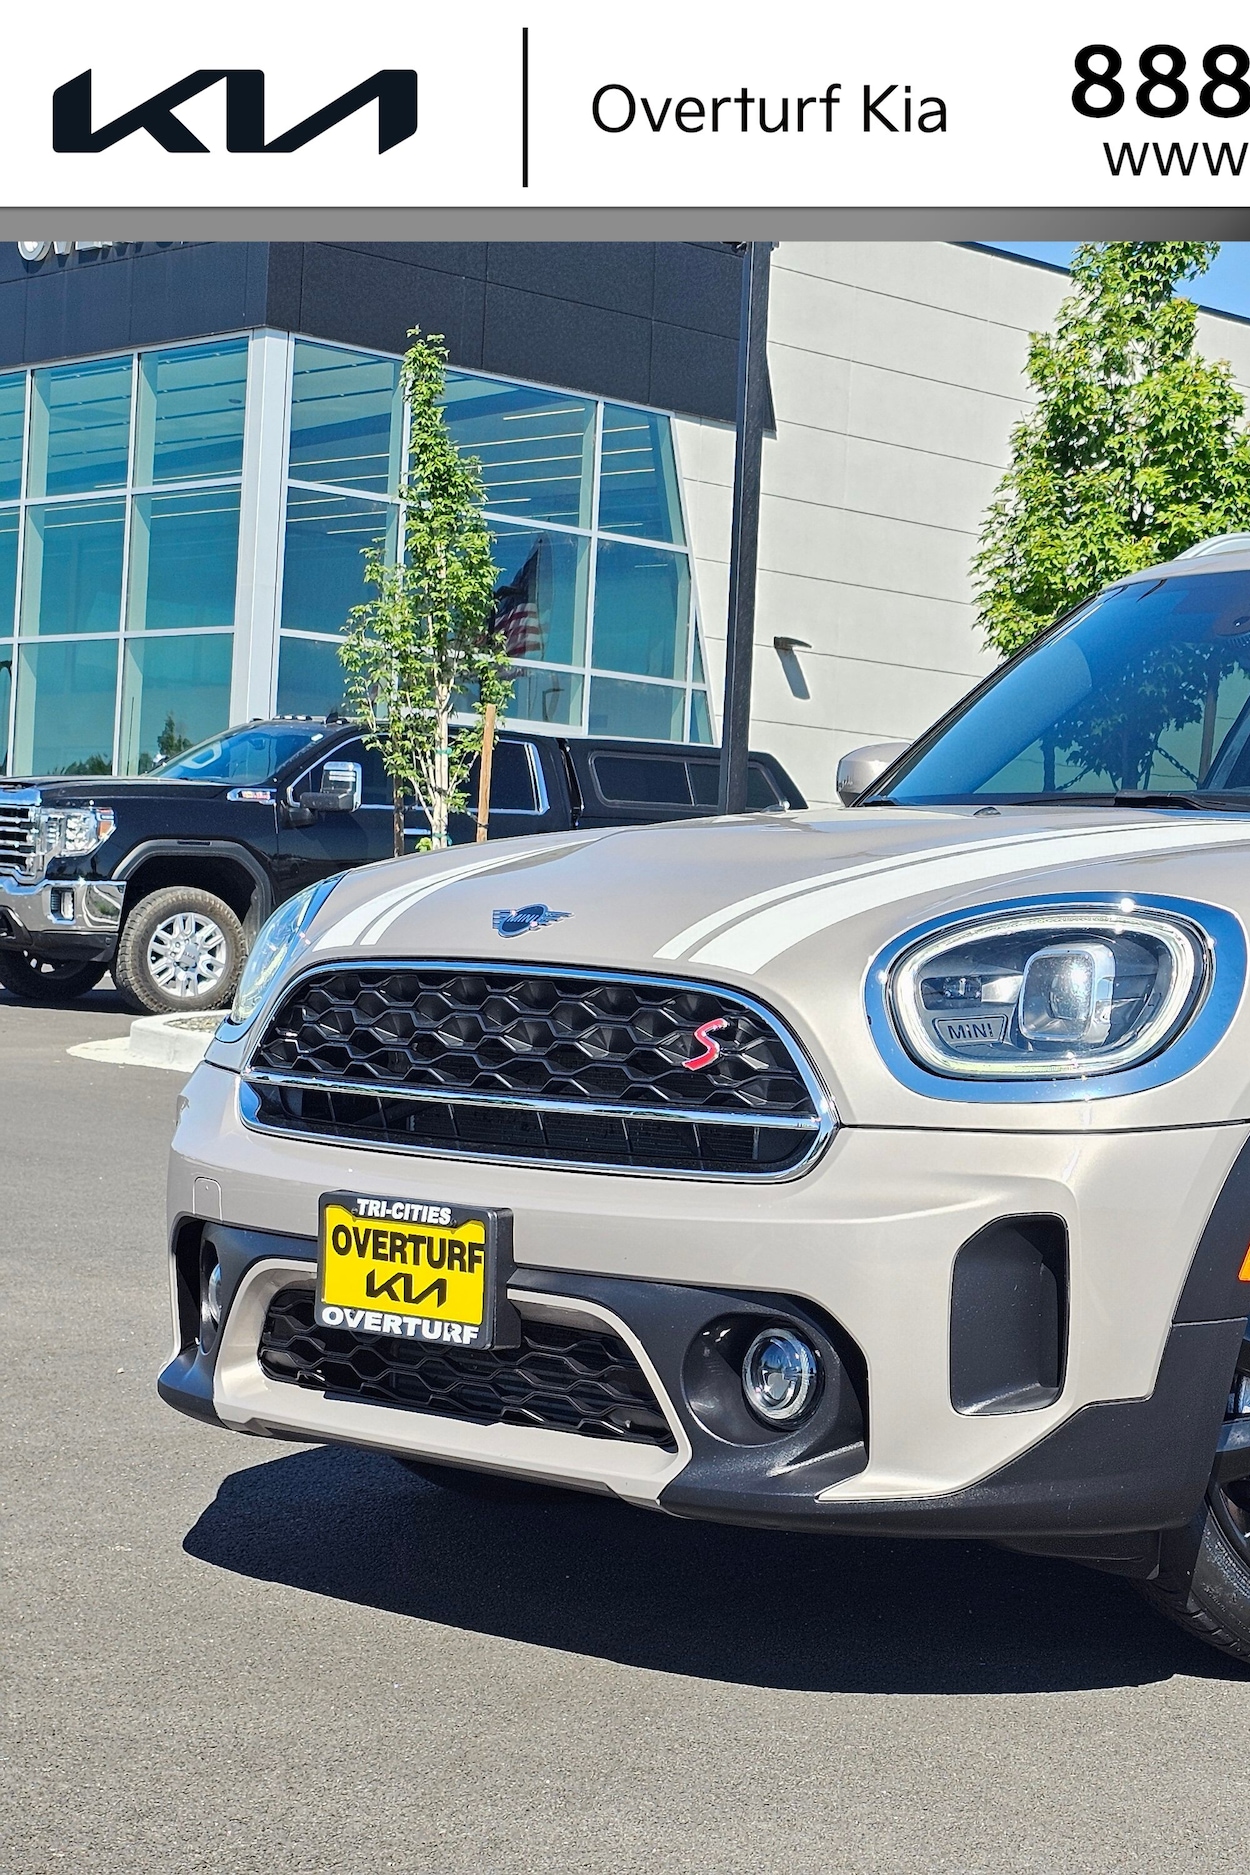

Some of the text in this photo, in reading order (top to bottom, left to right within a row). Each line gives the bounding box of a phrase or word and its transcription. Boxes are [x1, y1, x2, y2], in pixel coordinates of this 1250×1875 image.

[683, 1017, 728, 1071] S
[356, 1198, 452, 1226] TRI-CITIES
[331, 1224, 486, 1274] OVERTURF
[321, 1306, 481, 1345] OVERTURF
